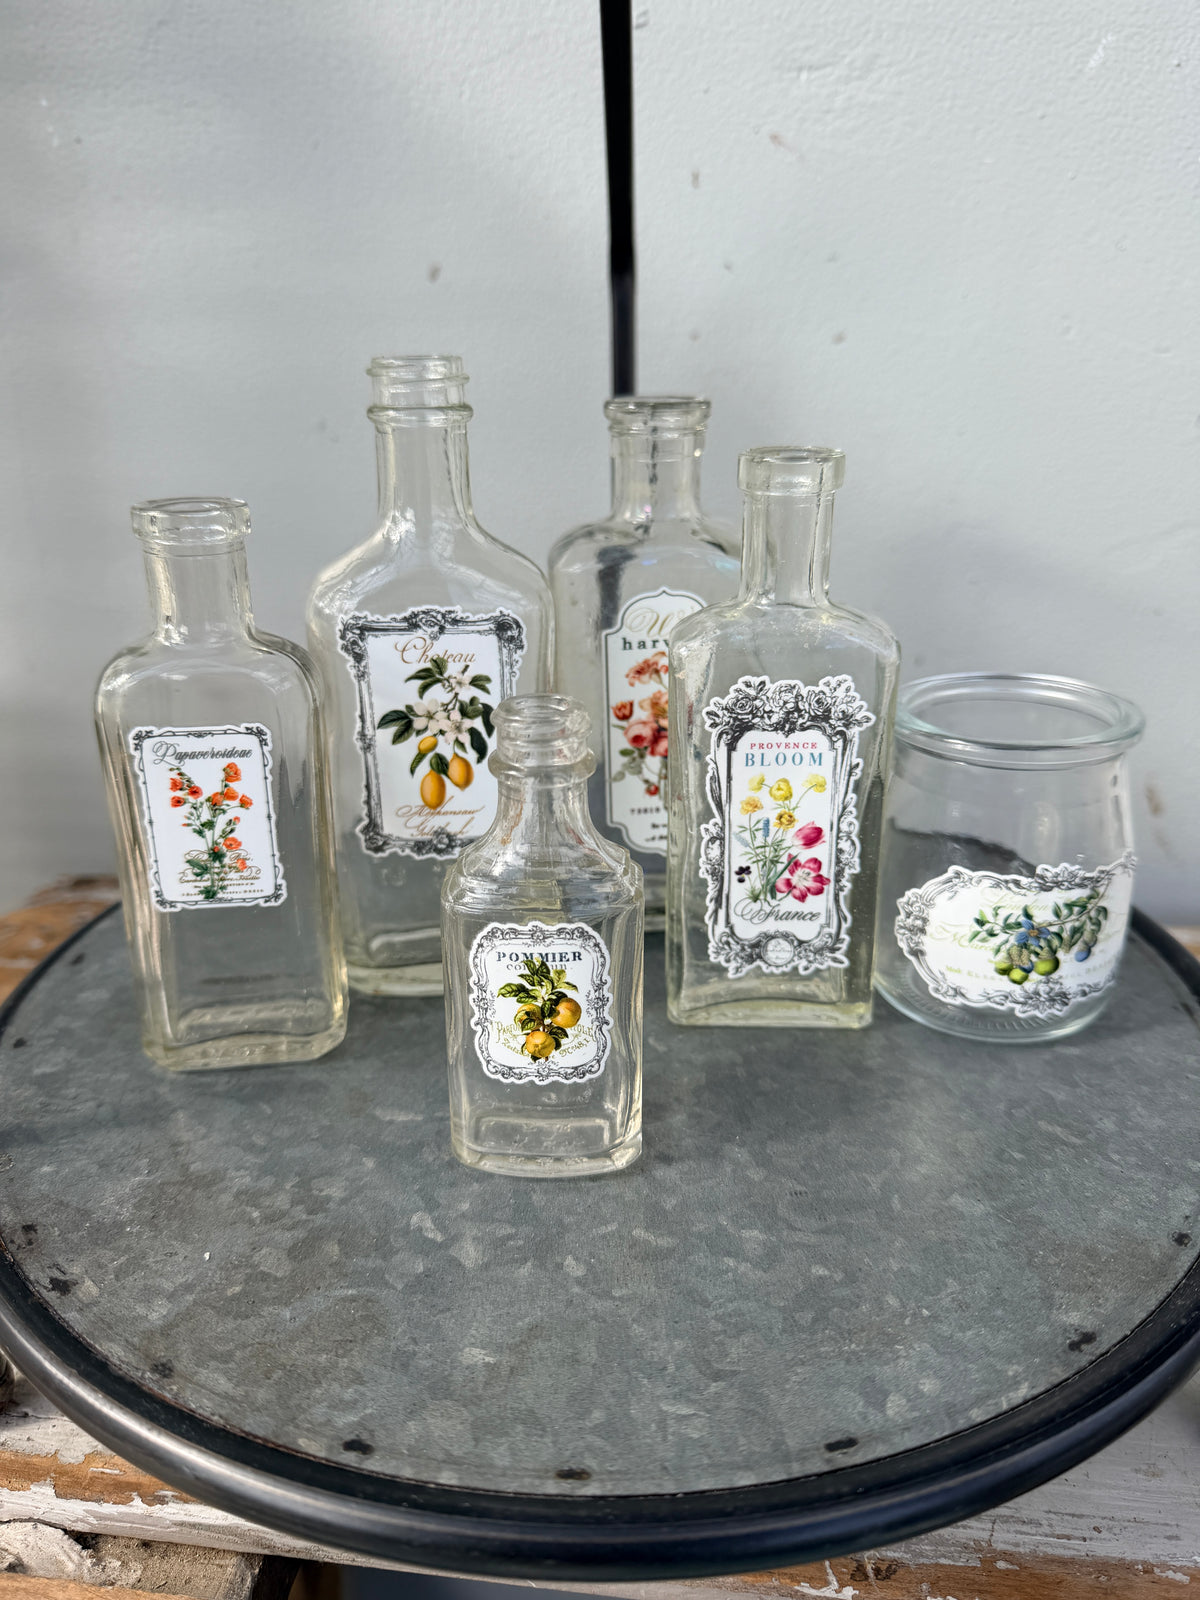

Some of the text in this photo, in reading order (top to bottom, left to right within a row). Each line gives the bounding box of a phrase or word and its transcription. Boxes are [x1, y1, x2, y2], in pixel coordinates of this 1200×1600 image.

[750, 742, 818, 750] PROVENCE
[153, 741, 253, 767] Papaveroideae
[744, 752, 823, 767] BLOOM
[734, 900, 821, 924] France
[496, 951, 583, 963] POMMIER
